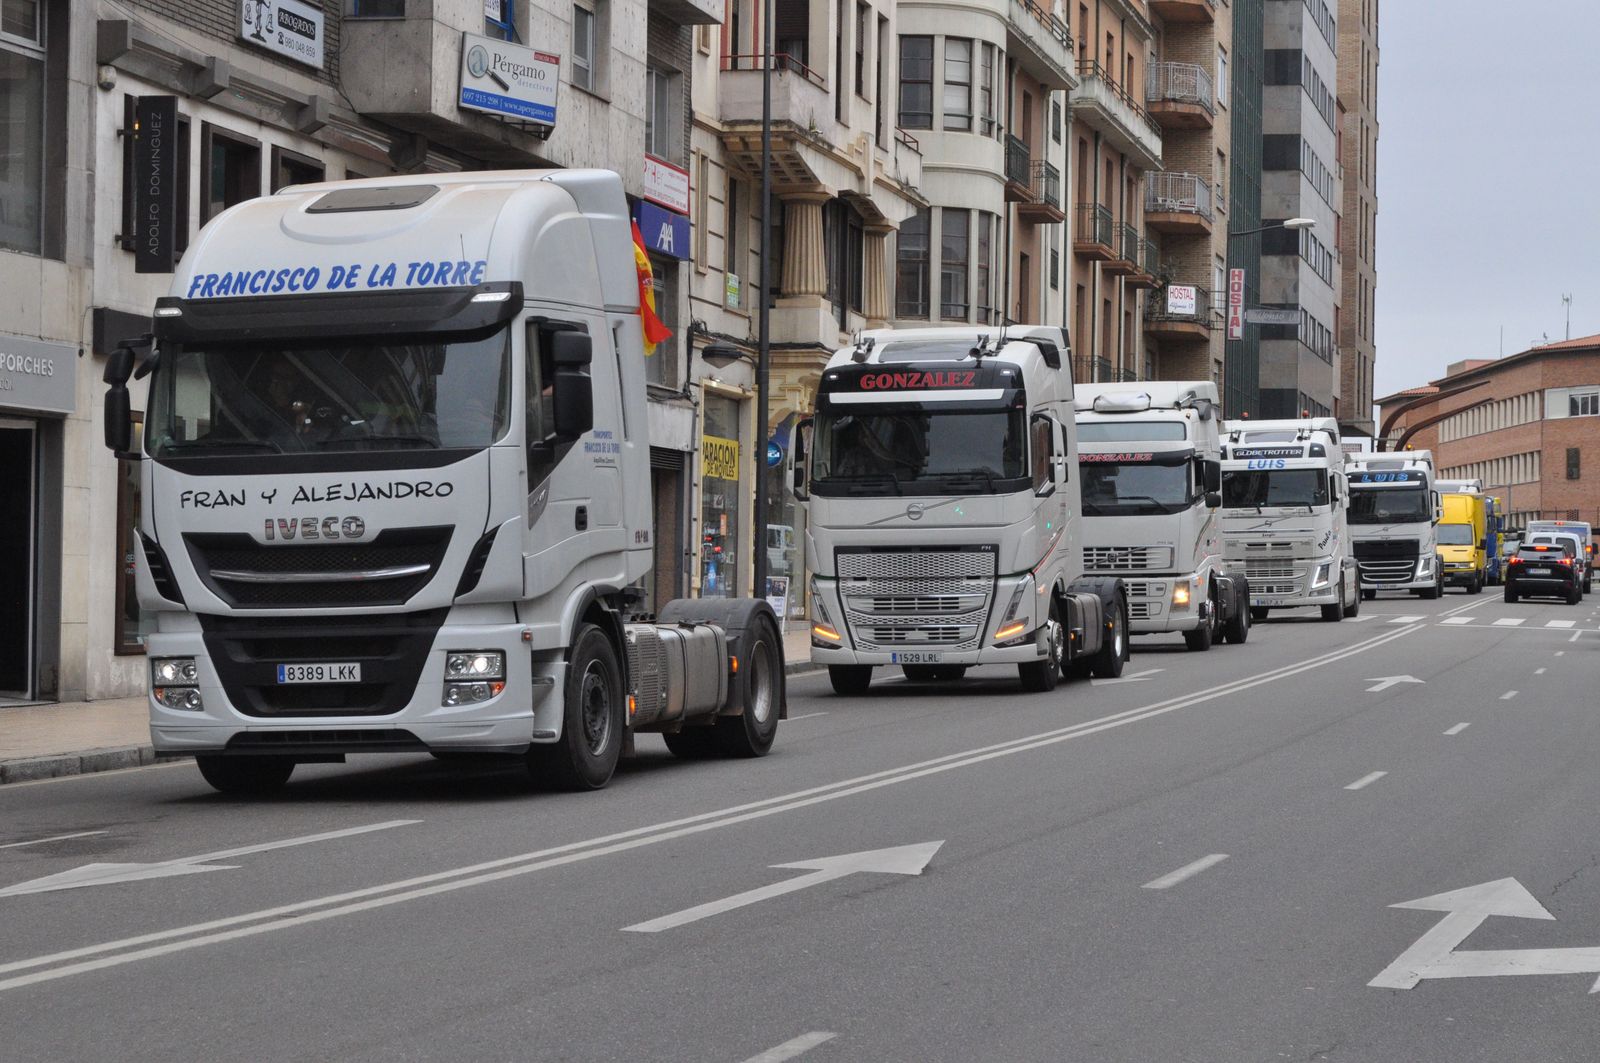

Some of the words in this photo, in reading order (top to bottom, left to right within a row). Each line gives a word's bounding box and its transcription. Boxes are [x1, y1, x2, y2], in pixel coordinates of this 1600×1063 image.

[279, 11, 315, 36] ABOGADOS
[285, 37, 294, 50] 980
[296, 41, 305, 53] 048
[306, 45, 316, 58] 859
[492, 53, 546, 80] Pérgamo
[517, 80, 553, 93] detectives
[475, 93, 487, 102] 215
[150, 112, 162, 196] DOMINGUEZ
[149, 203, 161, 257] ADOLFO
[656, 222, 674, 254] AXA
[187, 266, 321, 299] FRANCISCO
[326, 264, 361, 291] DE
[367, 262, 397, 288] LA
[405, 260, 488, 287] TORRE
[1170, 288, 1194, 300] HOSTAL
[1229, 270, 1243, 339] HOSTAL
[0, 353, 54, 376] PORCHES
[860, 371, 976, 389] GONZALEZ
[1078, 453, 1153, 462] GONZALEZ
[1236, 448, 1302, 457] GLOBETROTTER
[1248, 459, 1286, 470] LUIS
[1361, 472, 1409, 483] LUIS
[180, 489, 246, 509] FRAN
[261, 488, 277, 504] Y
[292, 481, 454, 505] ALEJANDRO
[264, 516, 366, 540] IVECO
[899, 653, 920, 663] 1529
[922, 653, 940, 663] LRL
[287, 666, 324, 681] 8389
[329, 665, 356, 680] LKK
